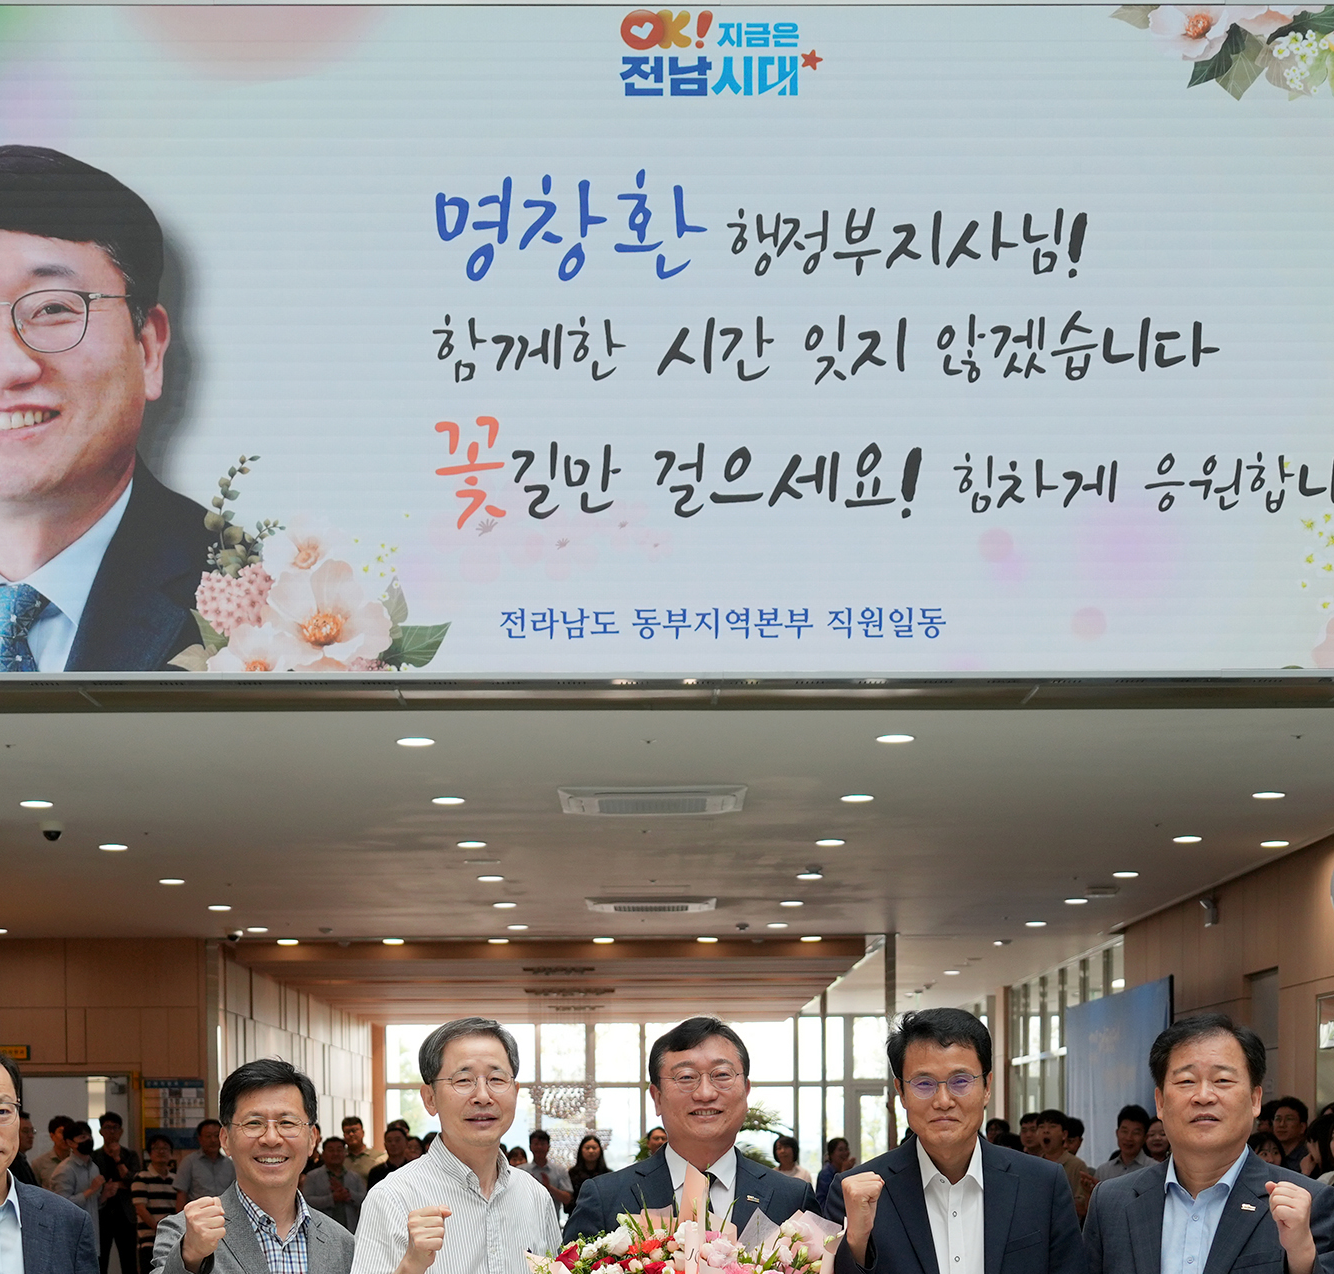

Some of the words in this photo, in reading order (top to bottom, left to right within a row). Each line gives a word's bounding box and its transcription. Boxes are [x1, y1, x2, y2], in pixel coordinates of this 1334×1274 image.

[620, 9, 713, 50] OK!
[717, 22, 800, 48] 지금은
[619, 56, 799, 96] 전남시대
[437, 170, 708, 282] 명창환
[728, 208, 1088, 279] 행정부지사님!
[434, 315, 627, 384] 함께한
[658, 317, 775, 382] 시간
[806, 316, 907, 386] 잊지
[938, 312, 1220, 384] 않겠습니다
[436, 417, 622, 530] 꽃길만
[656, 444, 923, 519] 걸으세요!
[955, 454, 1118, 514] 힘차게
[501, 609, 620, 640] 전라남도
[634, 609, 814, 640] 동부지역본부
[830, 608, 947, 639] 직원일동
